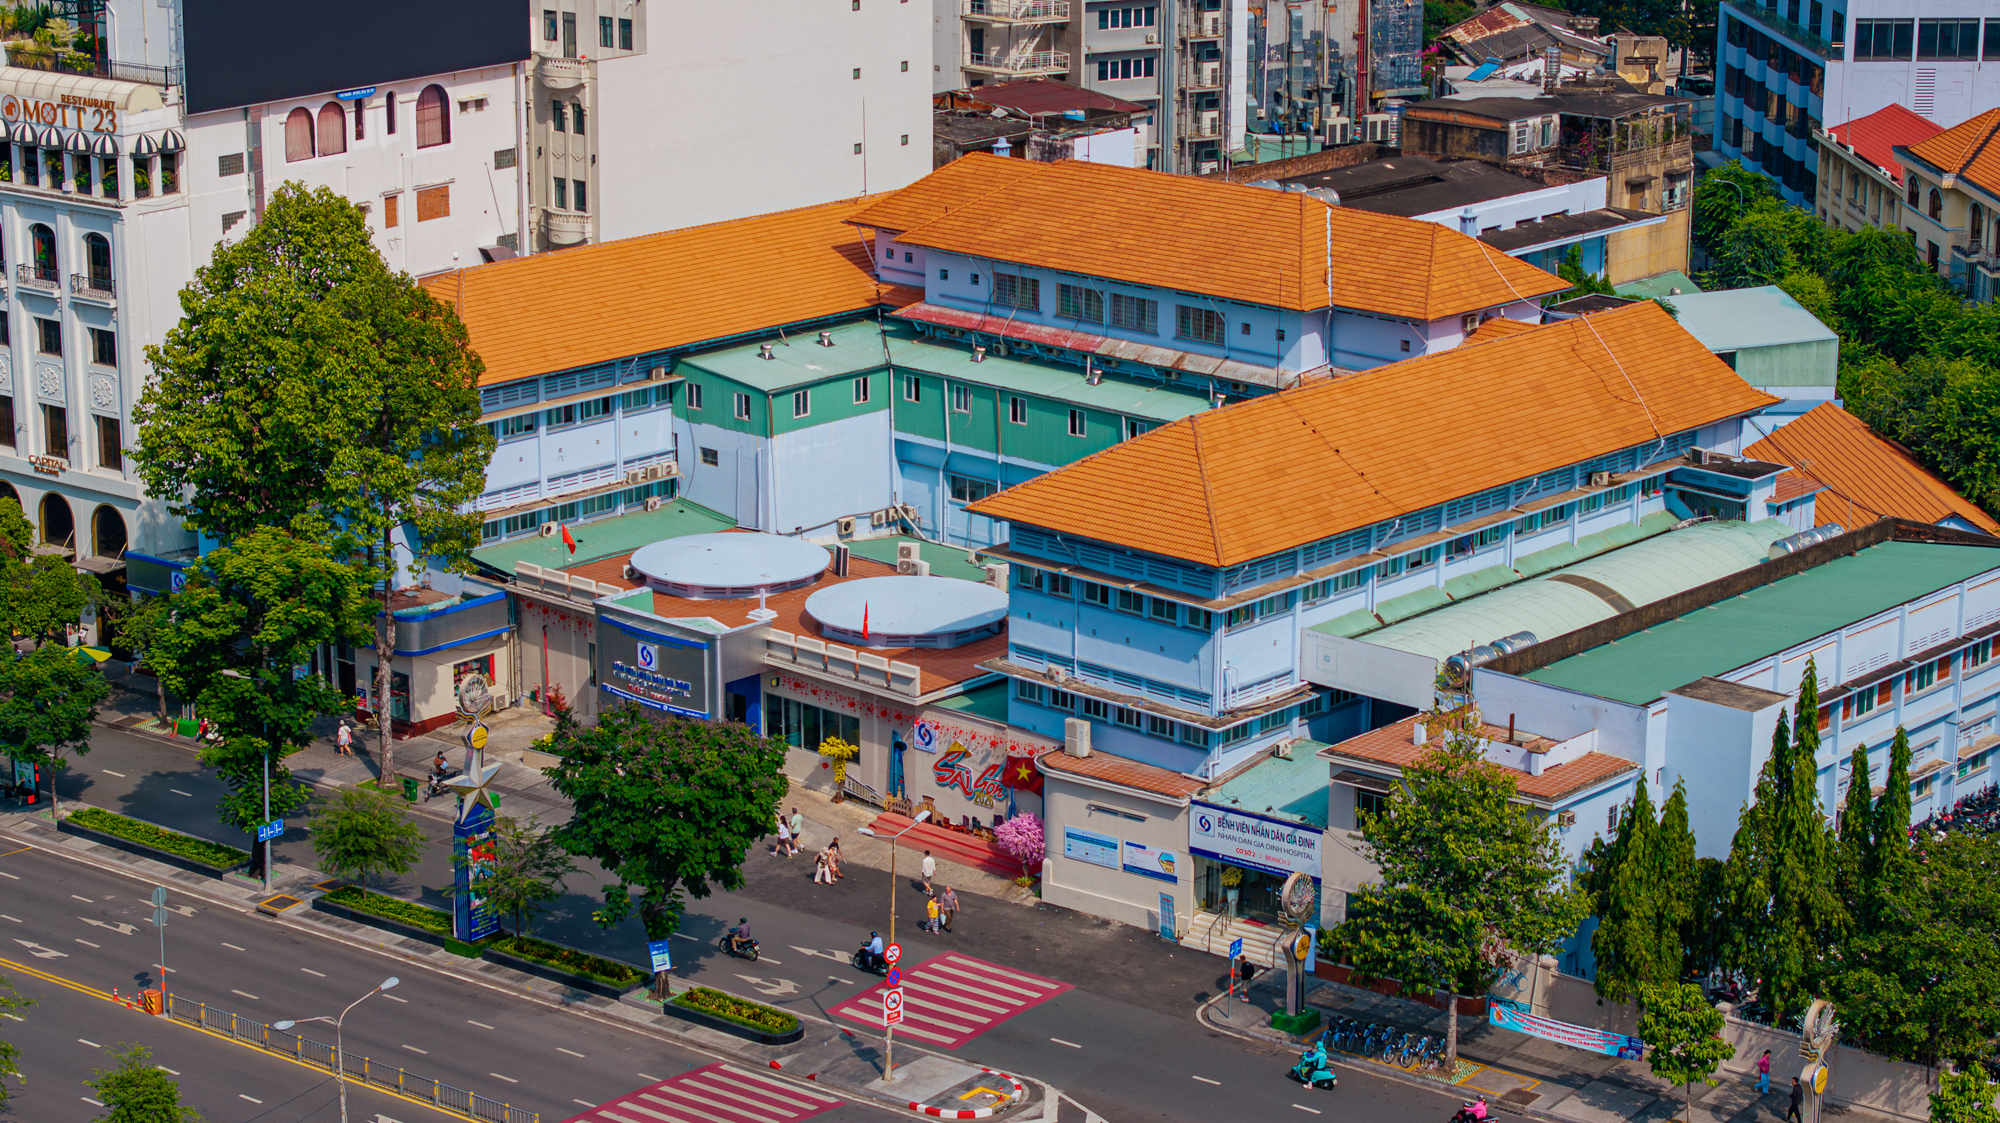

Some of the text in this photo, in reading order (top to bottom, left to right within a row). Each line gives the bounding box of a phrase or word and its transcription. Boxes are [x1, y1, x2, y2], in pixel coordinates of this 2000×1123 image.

[61, 94, 116, 110] RESTAURANT
[23, 98, 117, 134] MOTT 23
[28, 455, 67, 472] CAPITAL
[1218, 816, 1235, 831] BỆNH
[1235, 821, 1250, 836] VIỆN
[1251, 825, 1270, 839] NHÂN
[1271, 829, 1285, 843] DÂN
[1286, 834, 1297, 846] GIA
[1298, 836, 1315, 850] ĐỊNH
[1218, 832, 1314, 861] NHAN DAN GIA DINH HOSPITAL
[1264, 855, 1291, 867] BRANCH 2
